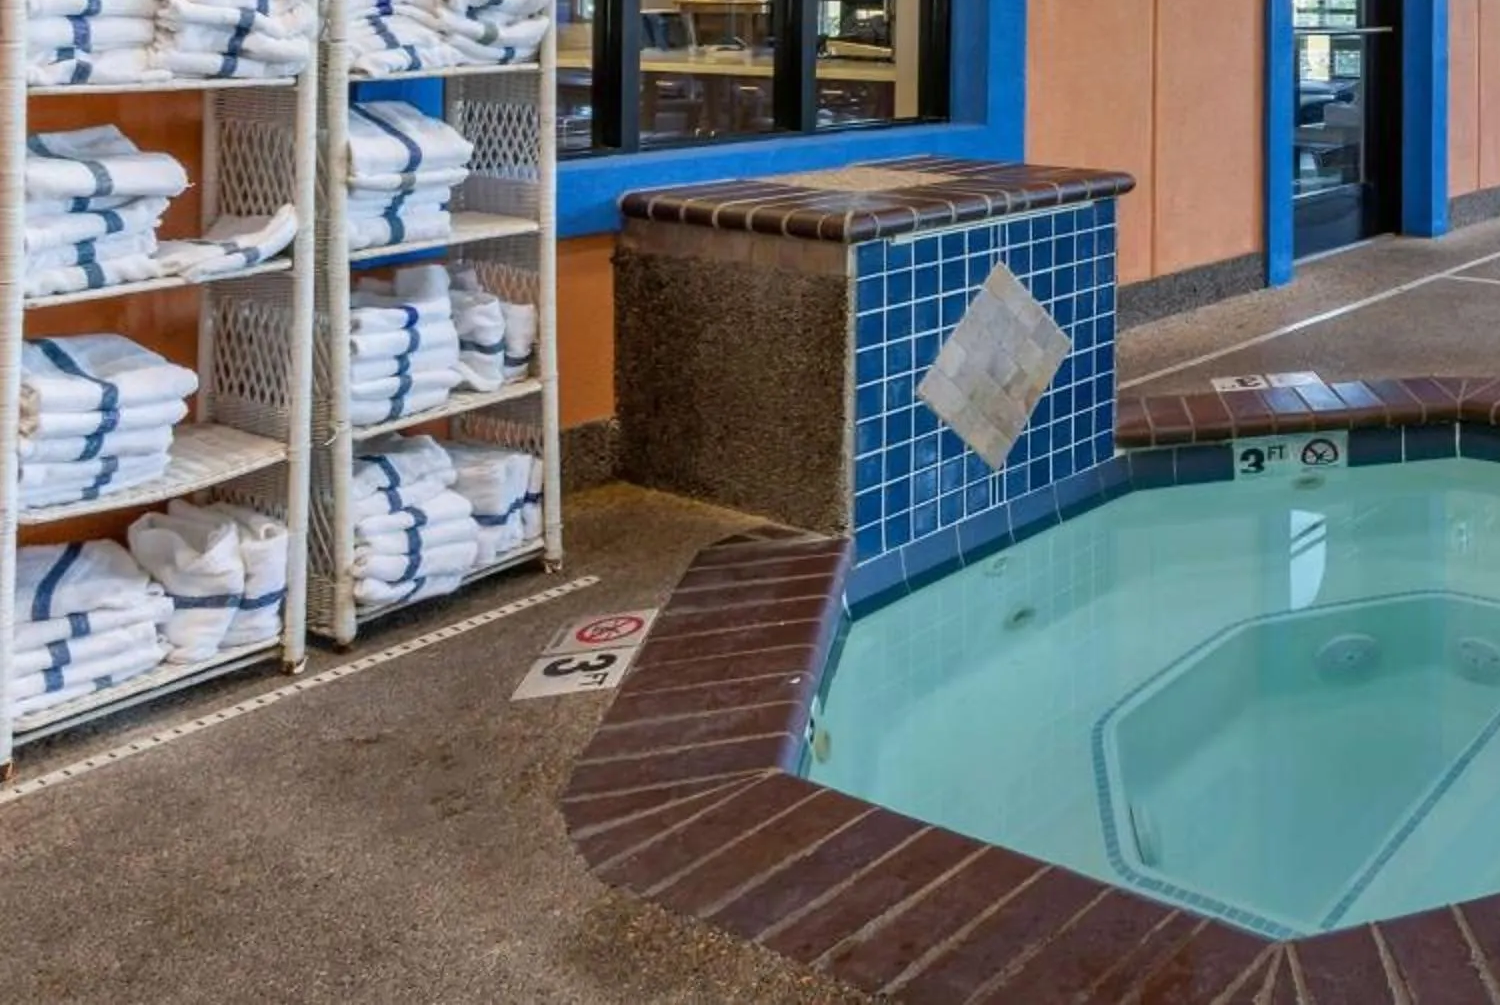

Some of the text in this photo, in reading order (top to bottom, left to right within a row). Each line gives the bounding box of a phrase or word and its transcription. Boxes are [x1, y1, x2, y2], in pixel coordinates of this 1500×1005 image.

[1240, 446, 1284, 474] 3 FT
[543, 654, 617, 677] 3
